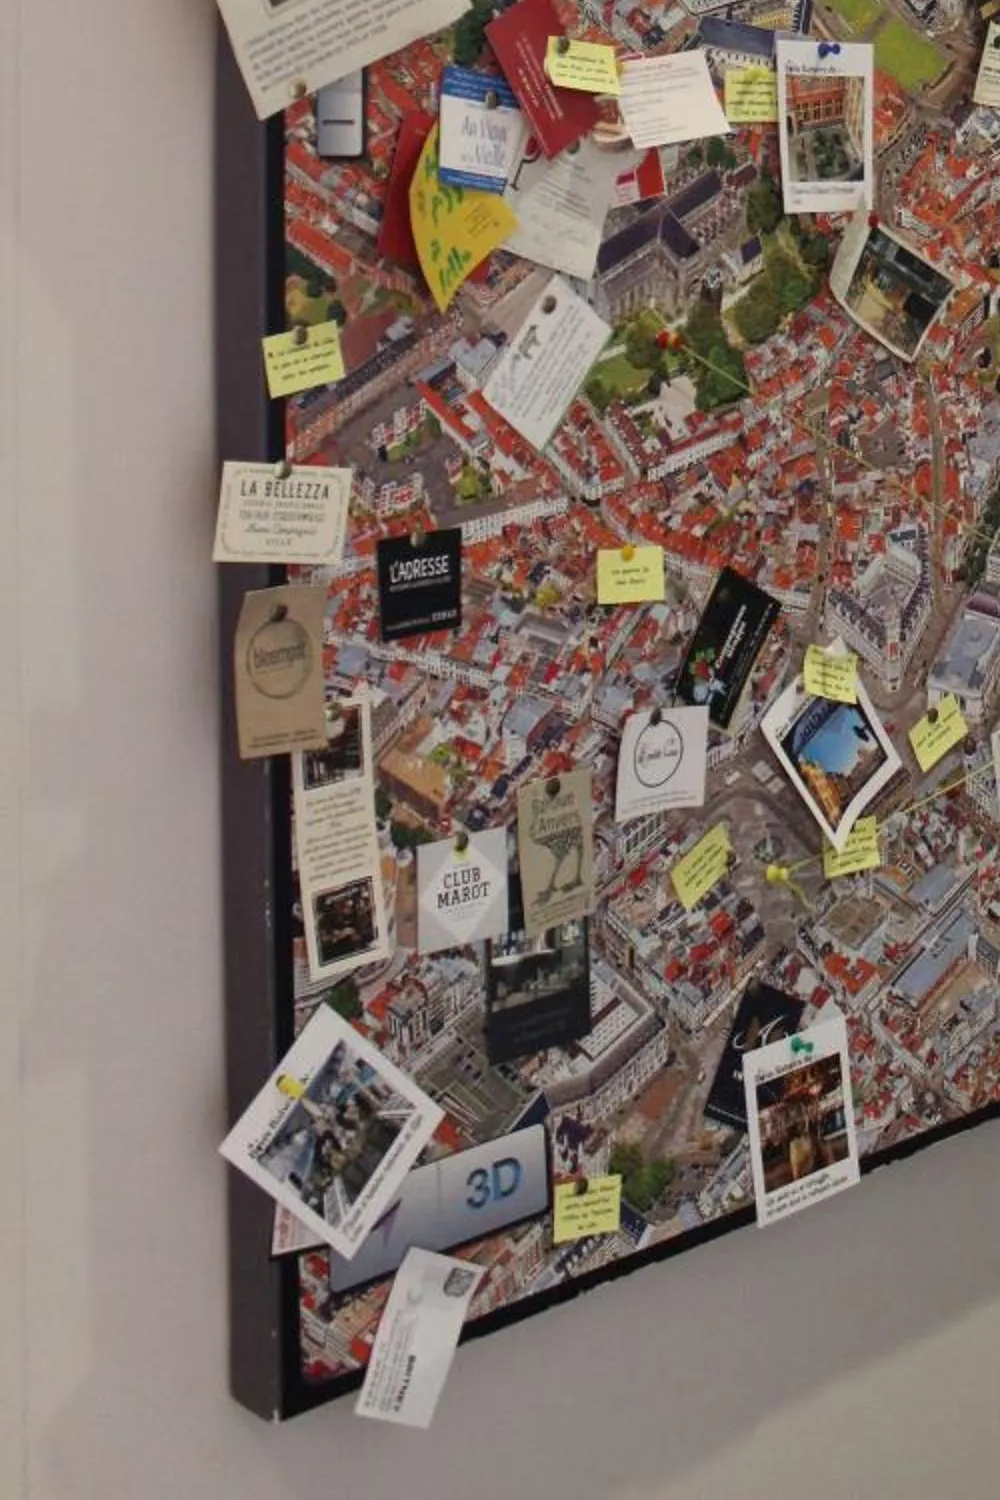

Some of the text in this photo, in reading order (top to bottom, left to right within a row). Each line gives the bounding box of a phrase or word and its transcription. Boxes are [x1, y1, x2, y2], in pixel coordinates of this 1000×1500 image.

[240, 480, 330, 500] LA BELLEZZA
[443, 866, 481, 889] CLUB
[437, 881, 491, 909] MAROT
[465, 1156, 522, 1210] 3D
